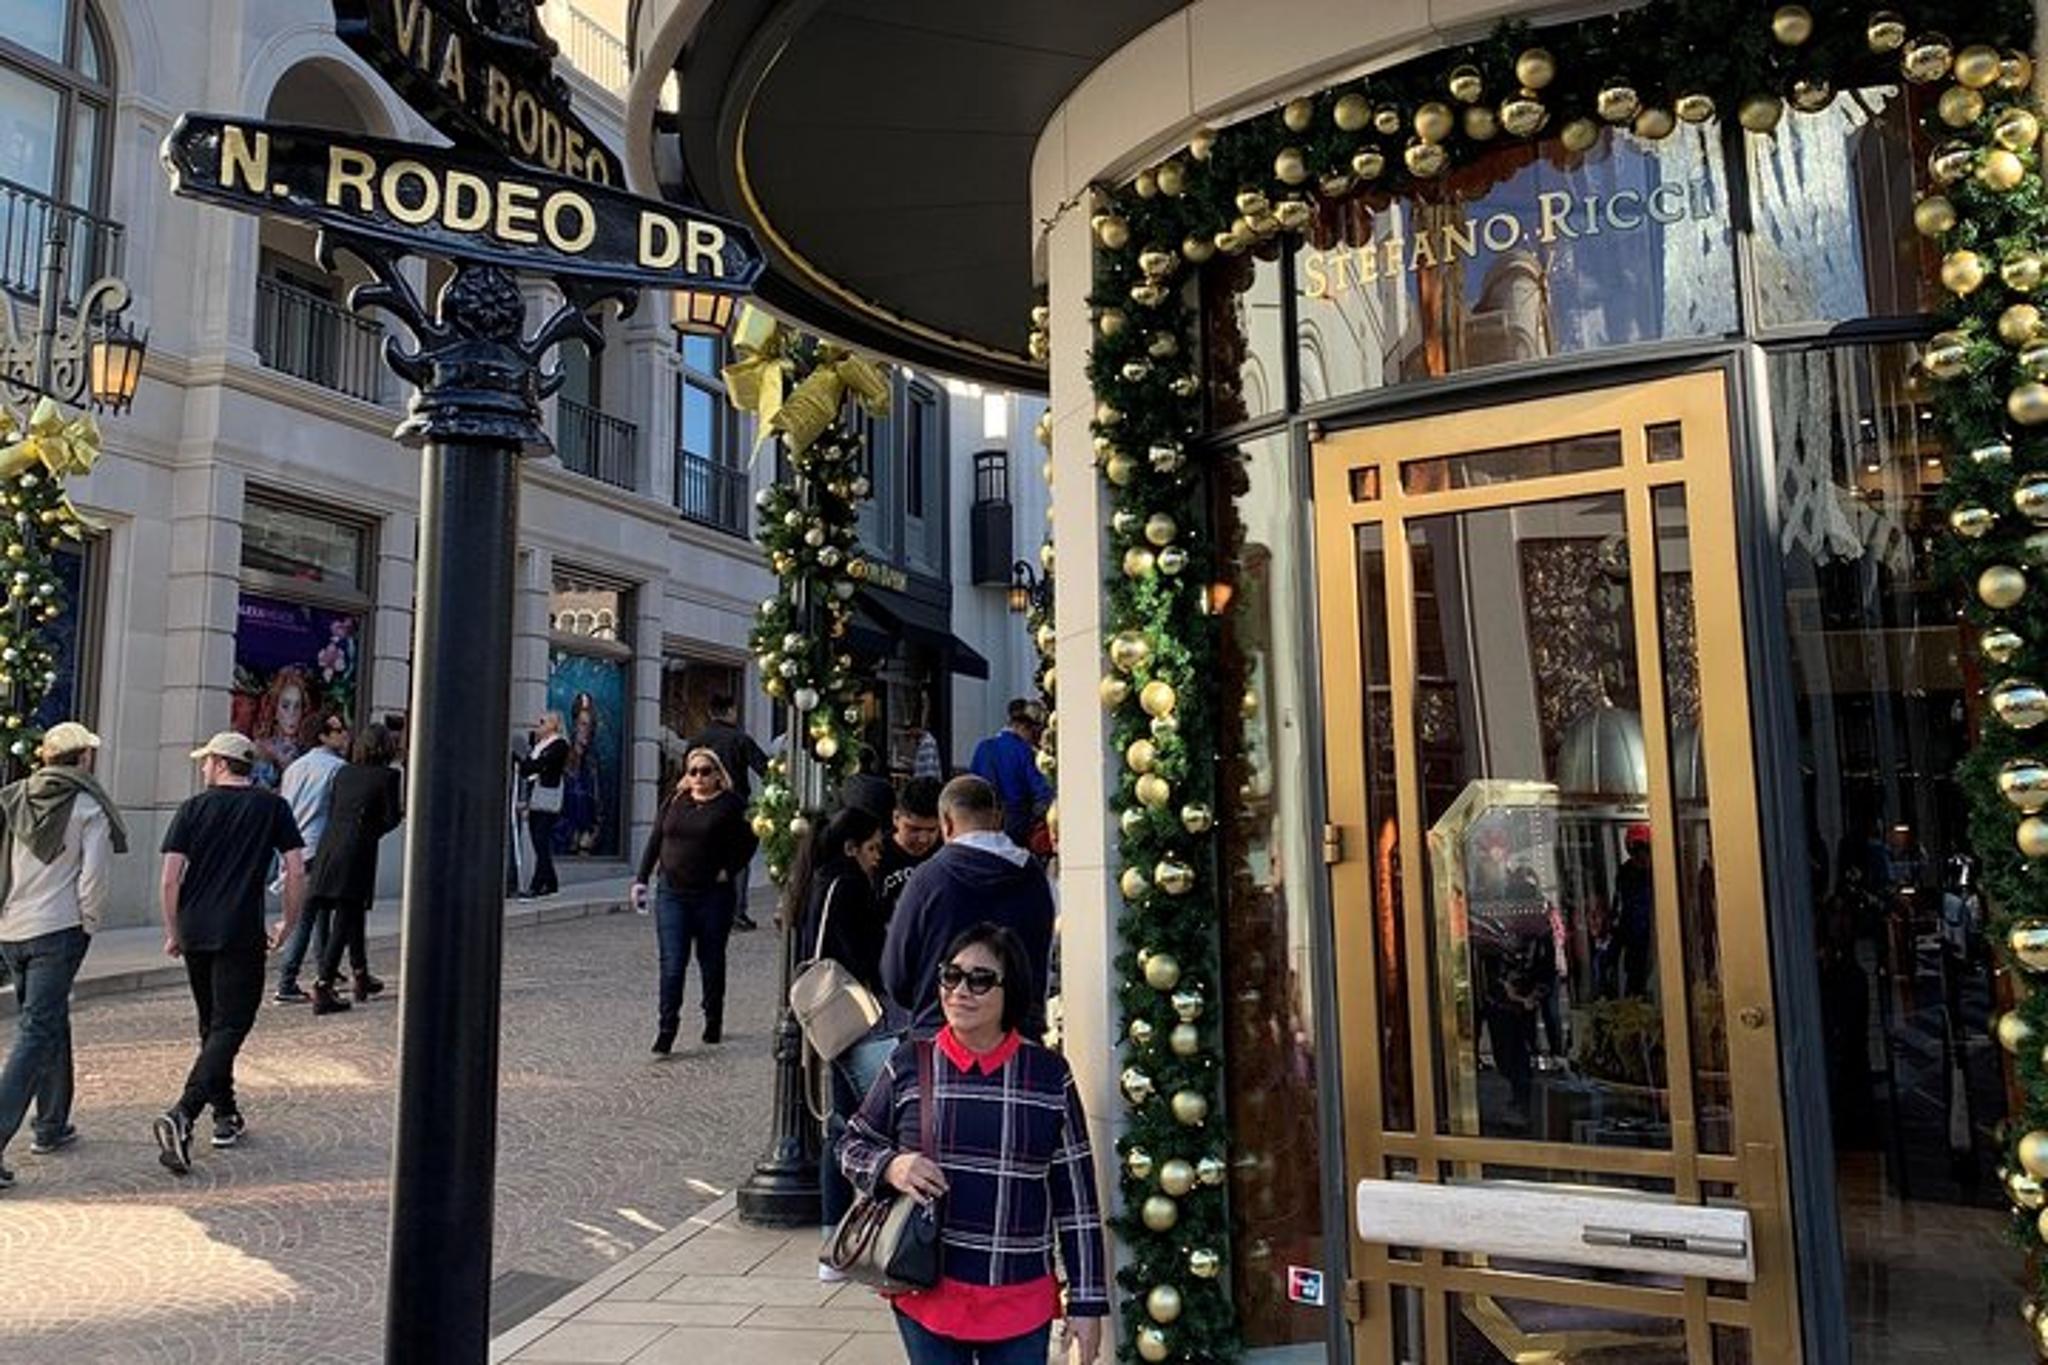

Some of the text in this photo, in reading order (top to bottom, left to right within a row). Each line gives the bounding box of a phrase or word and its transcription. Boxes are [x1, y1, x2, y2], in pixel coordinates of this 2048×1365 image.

[394, 0, 610, 187] VIA RODEO
[220, 125, 726, 278] N. RODEO DR
[1303, 178, 1714, 299] STEFANO RICCI
